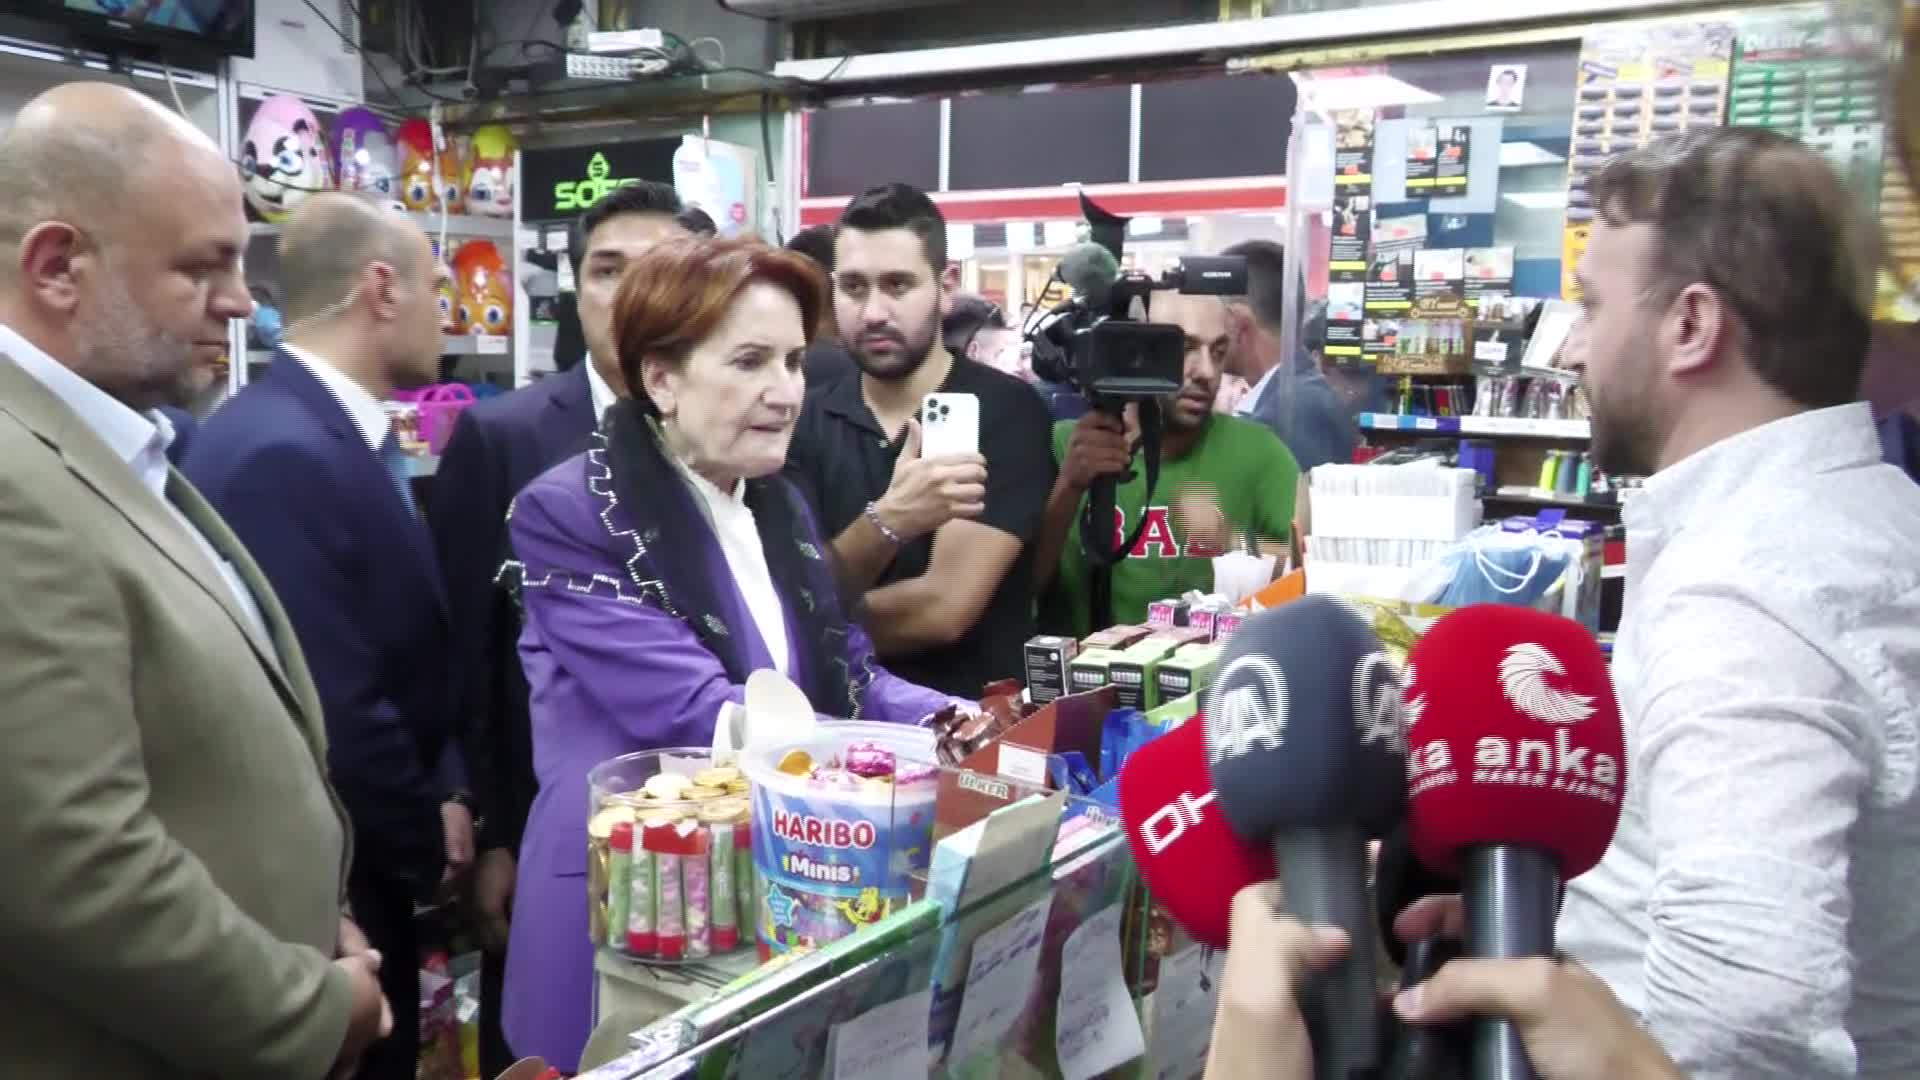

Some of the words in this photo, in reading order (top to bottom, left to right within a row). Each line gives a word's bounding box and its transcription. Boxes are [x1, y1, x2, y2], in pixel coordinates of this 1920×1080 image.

[1472, 726, 1618, 787] anka
[1472, 768, 1547, 787] HABER
[773, 810, 875, 848] HARIBO
[790, 855, 851, 882] Minis
